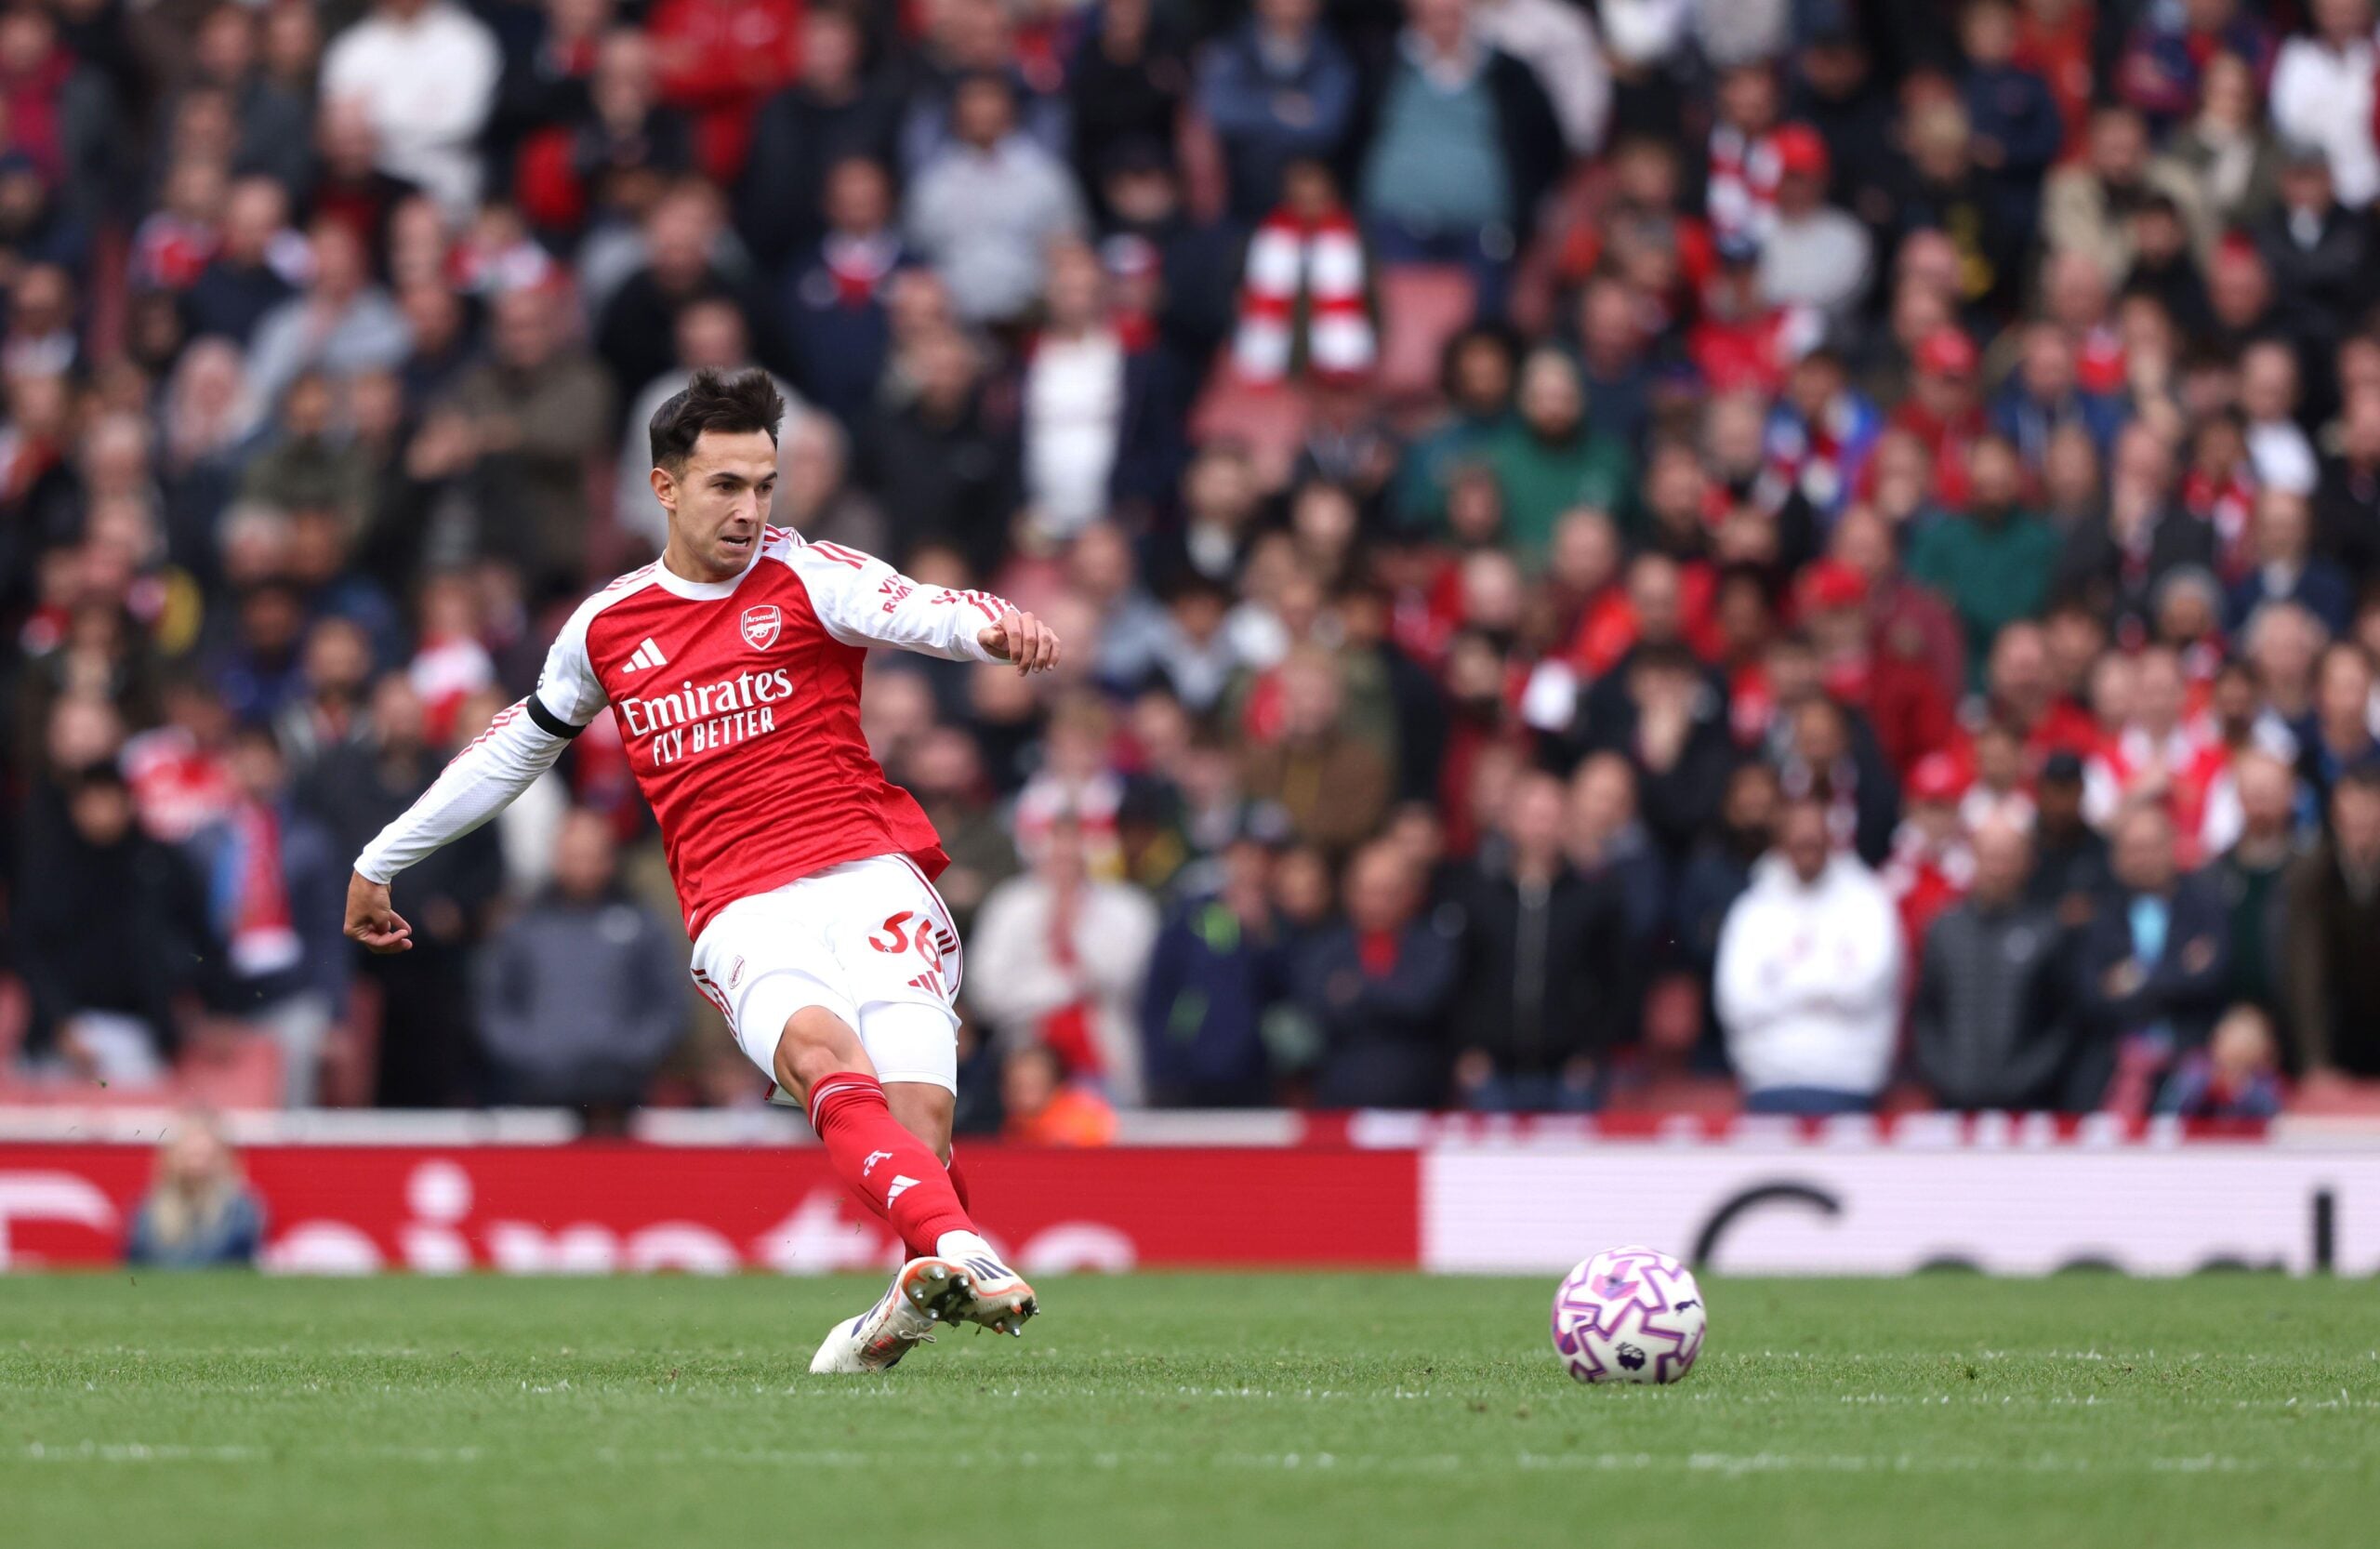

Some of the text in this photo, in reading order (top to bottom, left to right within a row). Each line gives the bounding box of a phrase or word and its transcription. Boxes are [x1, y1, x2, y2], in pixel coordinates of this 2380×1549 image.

[747, 613, 775, 623] Arsenal
[619, 668, 793, 736] Emirates
[653, 706, 775, 767] FLY BETTER
[867, 910, 942, 973] 56
